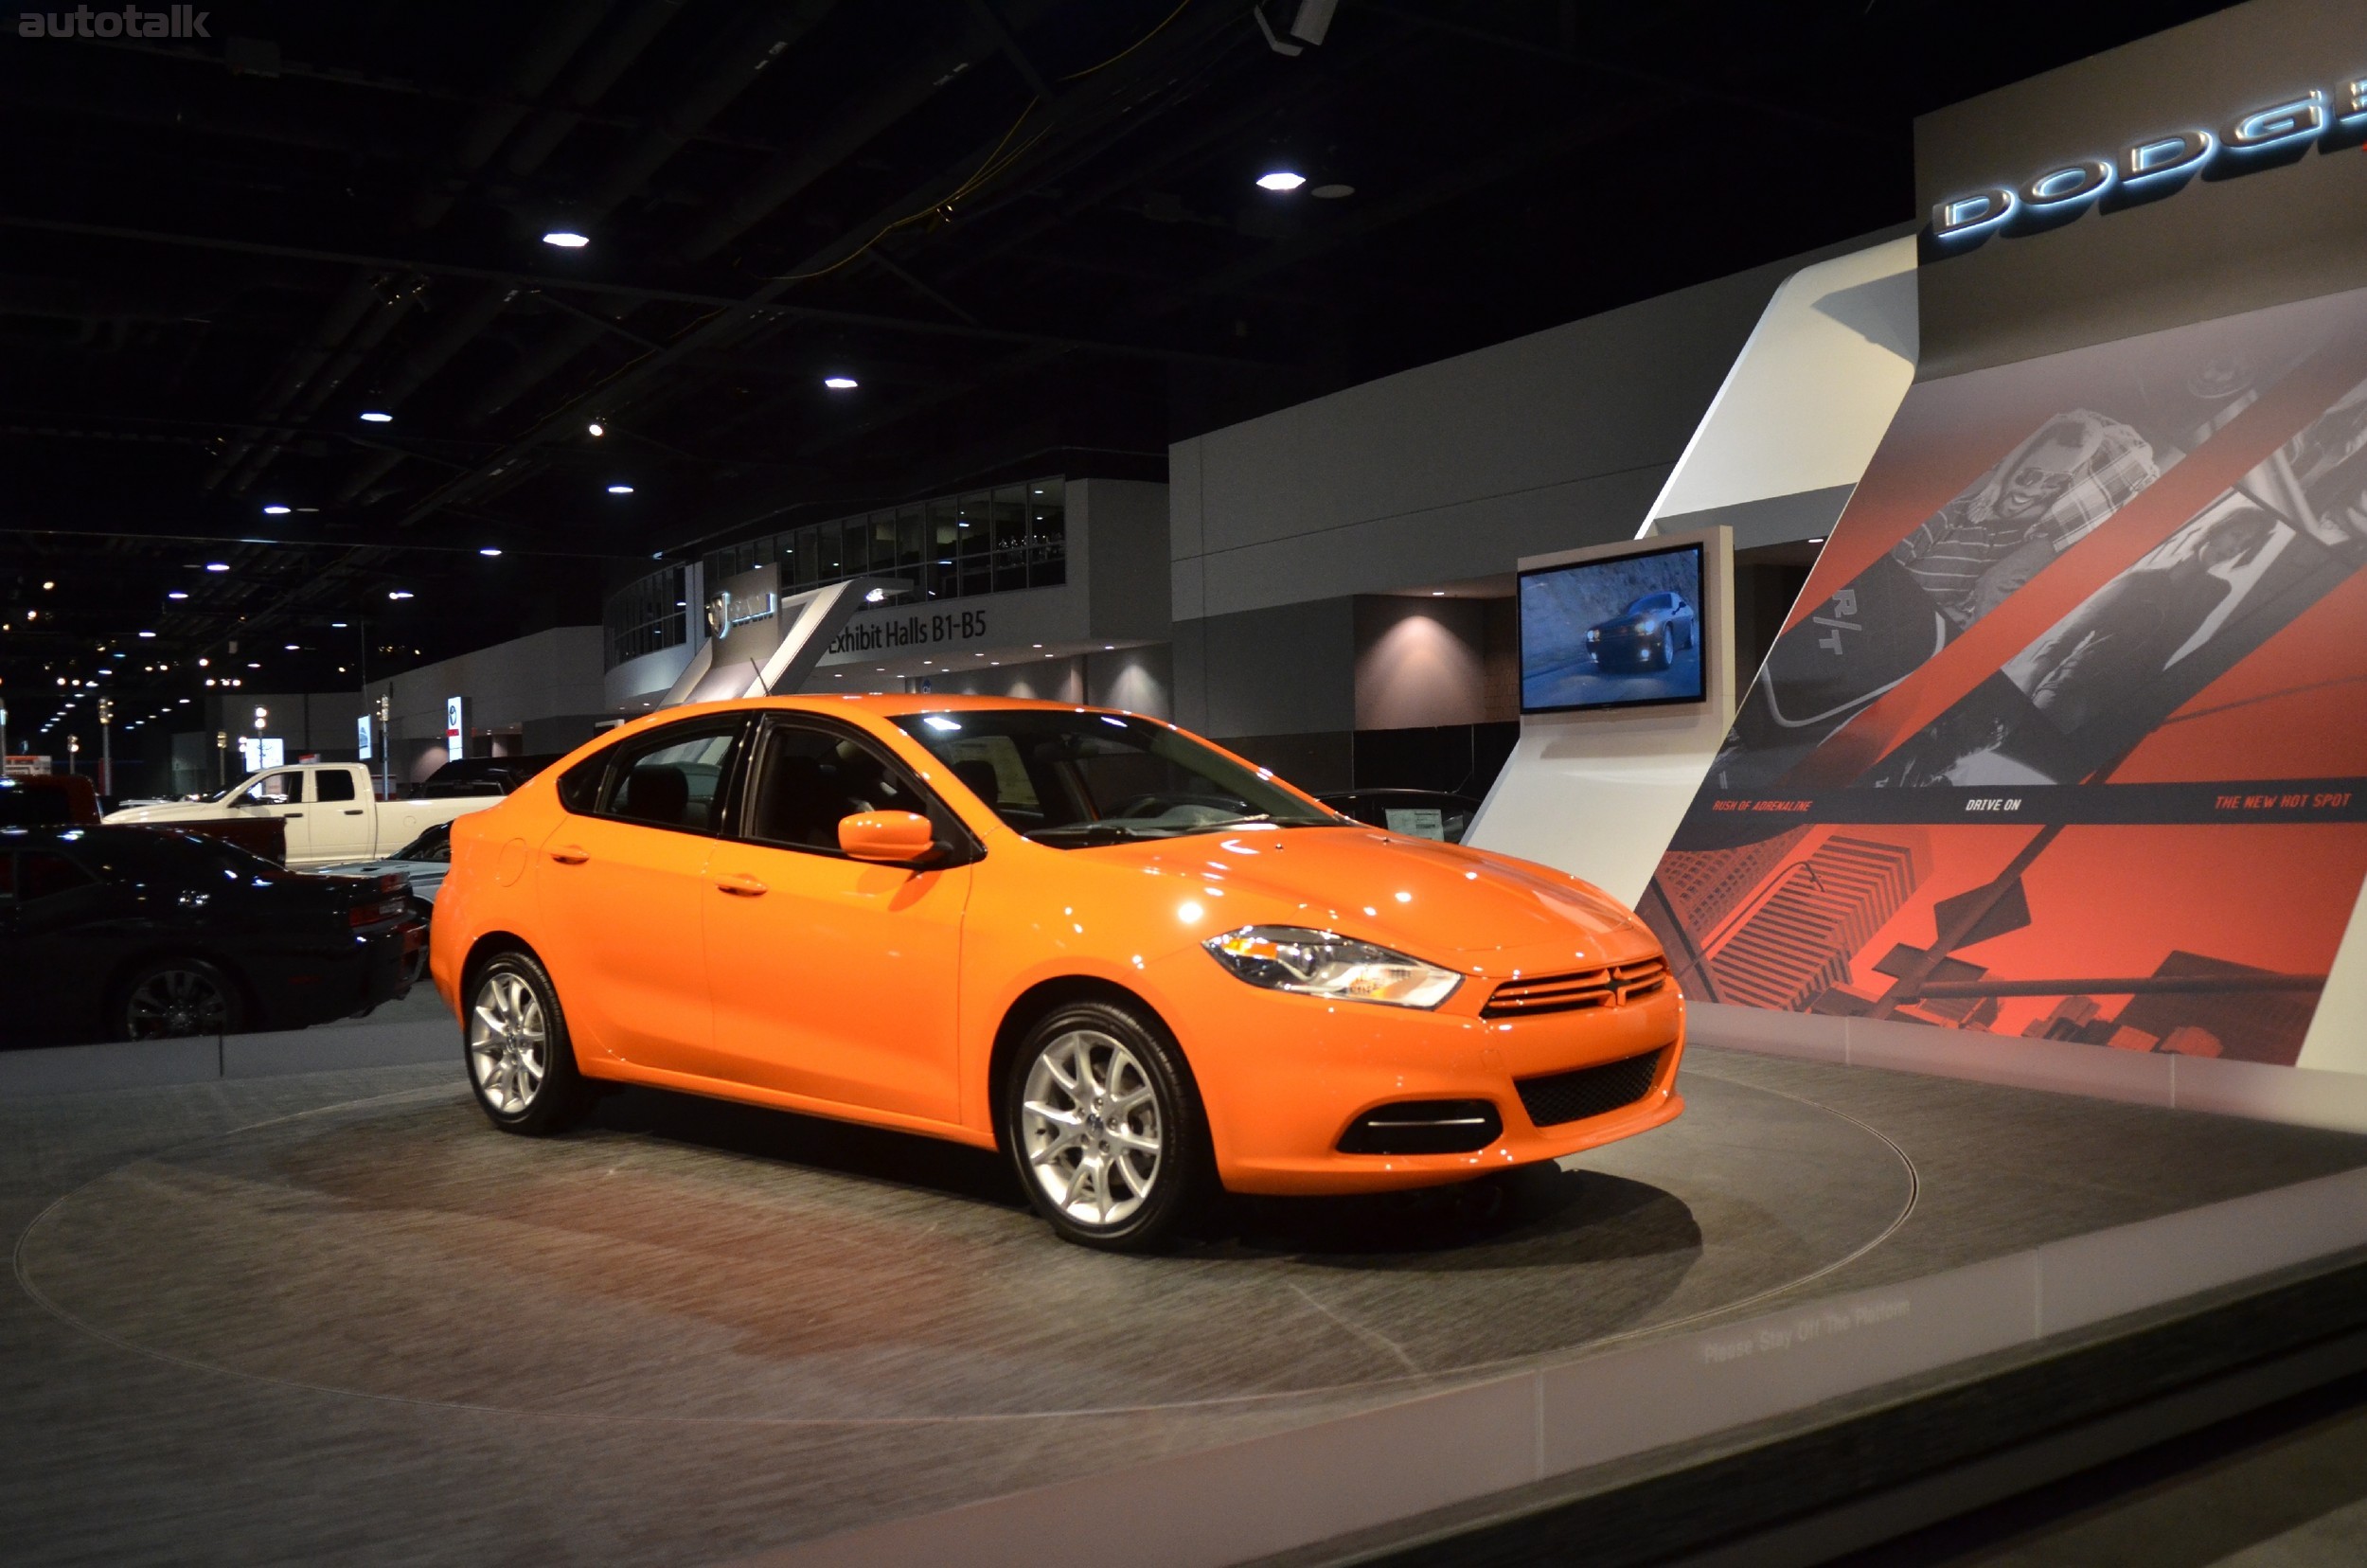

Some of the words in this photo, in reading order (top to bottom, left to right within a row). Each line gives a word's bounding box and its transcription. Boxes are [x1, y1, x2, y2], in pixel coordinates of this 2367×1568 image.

[885, 621, 927, 647] Halls
[932, 610, 987, 641] B1-B5
[1712, 800, 1736, 811] RUSH
[1737, 800, 1751, 811] OF
[1751, 800, 1813, 811] ADRENALINE
[1965, 799, 2002, 811] DRIVE
[2002, 798, 2022, 811] ON
[2214, 795, 2241, 810] THE
[2243, 794, 2278, 810] NEW
[2279, 793, 2309, 809] HOT
[2312, 793, 2353, 808] SPOT
